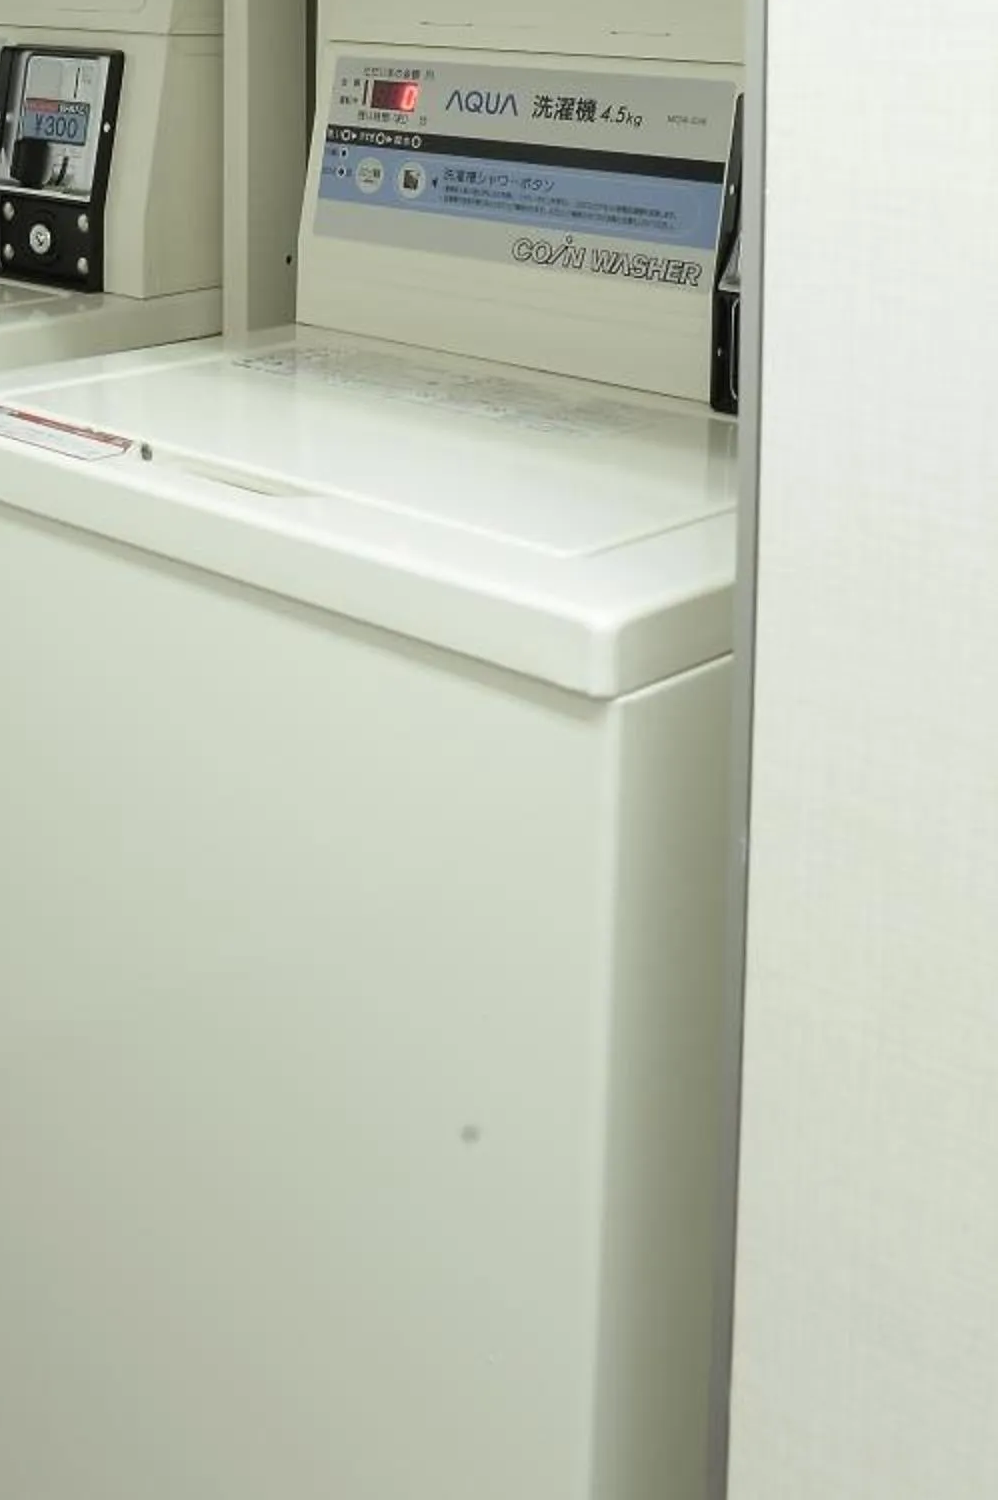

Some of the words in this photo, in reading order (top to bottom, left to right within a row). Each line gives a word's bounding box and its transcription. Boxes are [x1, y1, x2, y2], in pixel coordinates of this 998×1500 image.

[35, 112, 80, 139] ¥300
[445, 88, 519, 117] AQUA
[531, 94, 598, 123] 洗濯機
[599, 104, 644, 128] 4.5kg
[591, 248, 703, 287] WASHER
